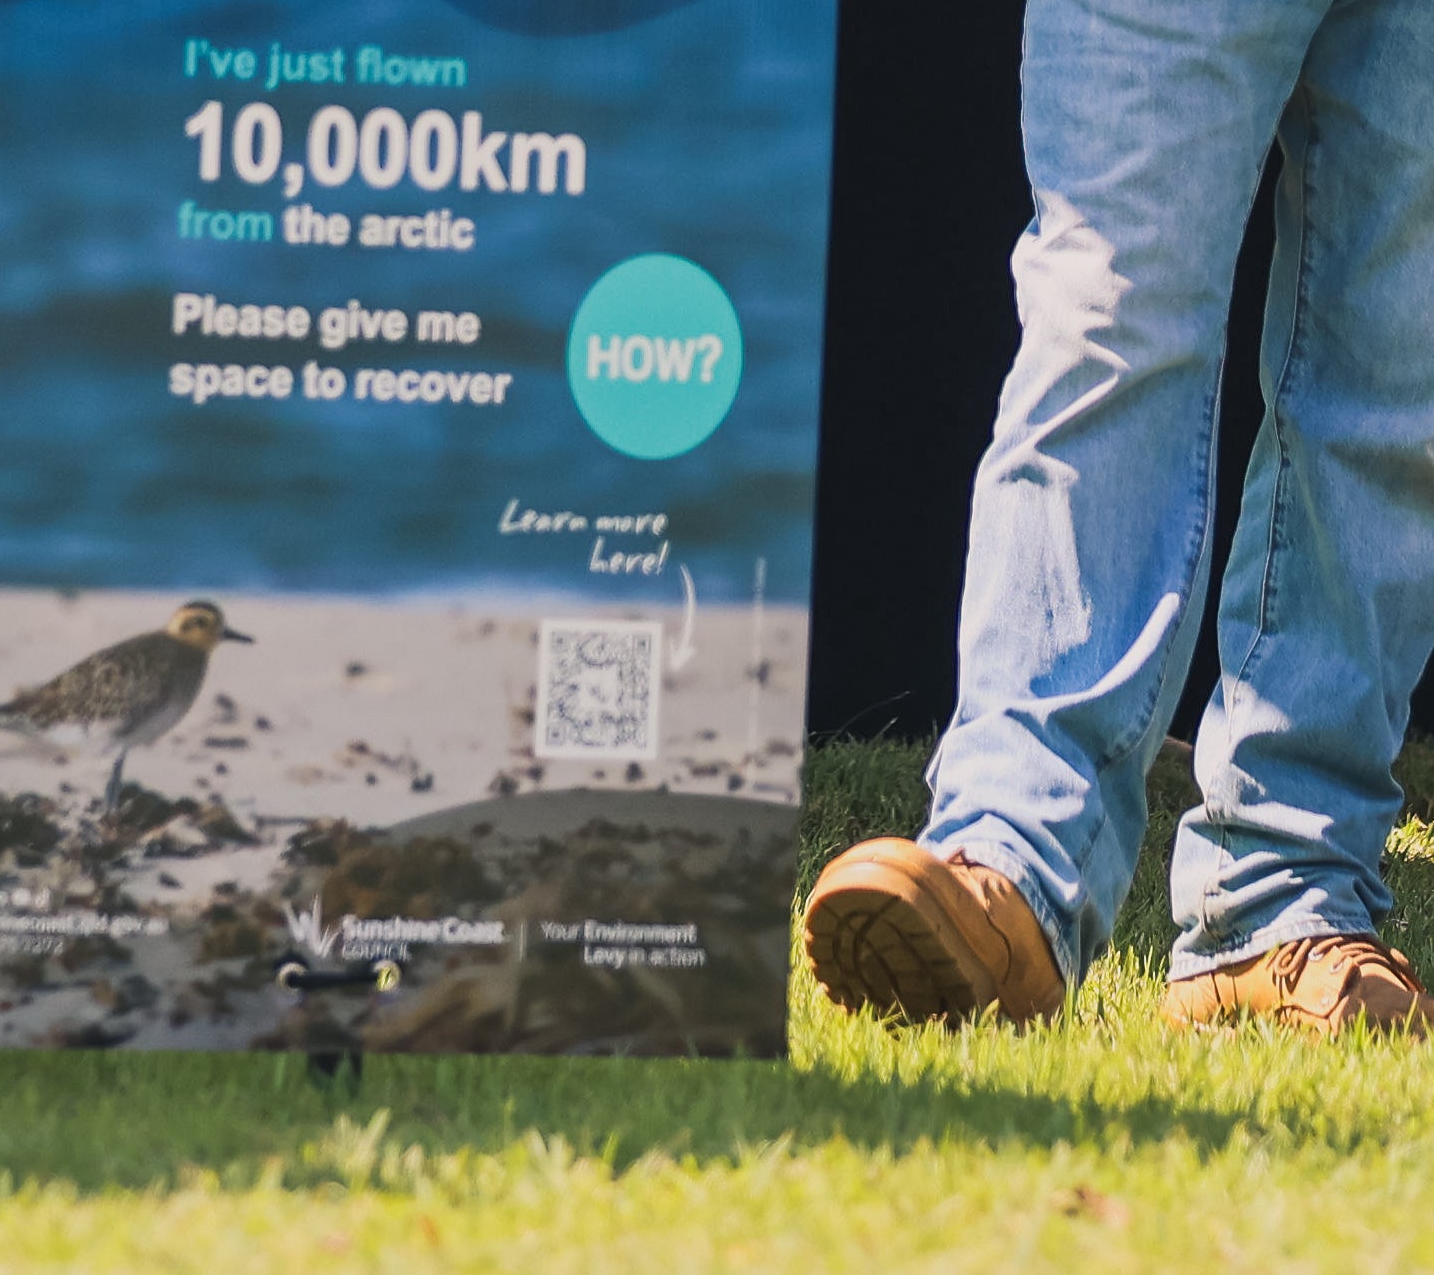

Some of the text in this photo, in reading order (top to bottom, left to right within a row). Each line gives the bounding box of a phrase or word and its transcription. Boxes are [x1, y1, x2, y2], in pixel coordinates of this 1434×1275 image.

[183, 38, 467, 90] I've just flown
[184, 99, 588, 199] 10,000km
[177, 200, 476, 251] from the arctic
[171, 291, 482, 349] Please give me
[169, 359, 512, 407] space to recover
[585, 333, 725, 384] HOW?
[498, 498, 667, 536] Learn more
[341, 913, 439, 945] Sunshine
[583, 918, 698, 945] Environment
